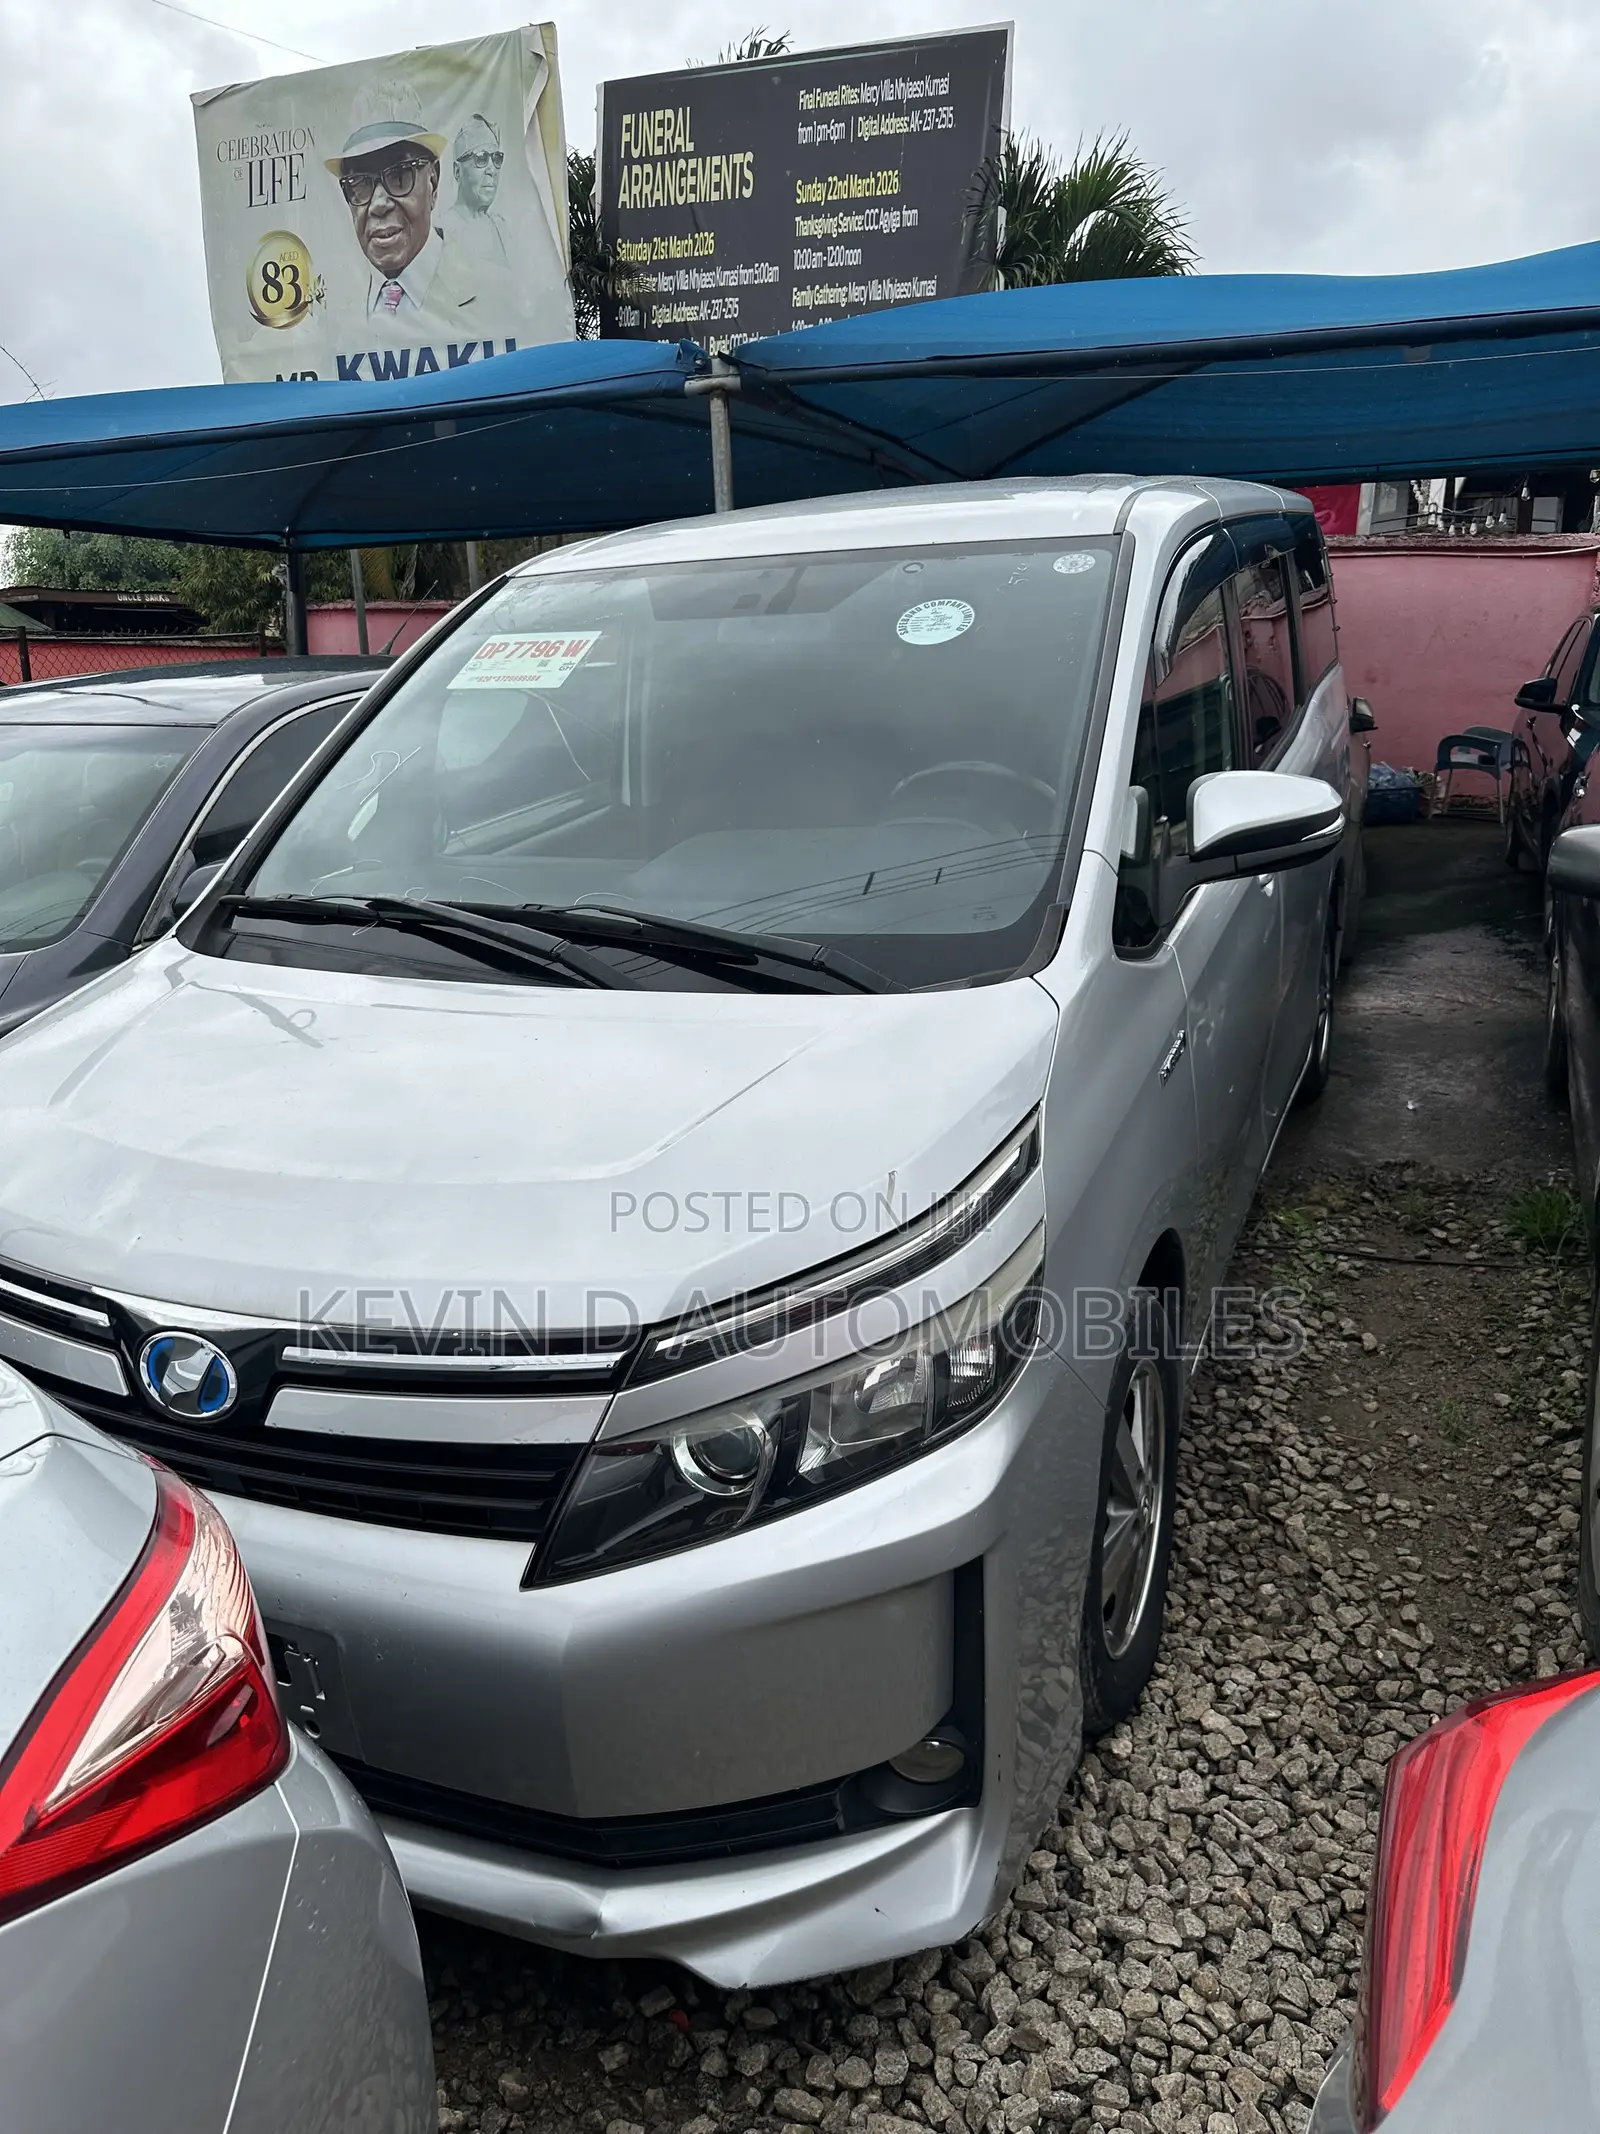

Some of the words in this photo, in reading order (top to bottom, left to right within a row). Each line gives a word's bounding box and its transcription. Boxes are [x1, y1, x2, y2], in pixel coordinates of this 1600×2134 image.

[799, 88, 816, 111] Final
[815, 84, 841, 109] Funeral
[841, 84, 860, 106] Rites:
[860, 82, 881, 107] Mercy
[880, 78, 895, 102] Villa
[924, 72, 950, 97] Kumasi
[217, 126, 315, 163] CELEBRATION
[620, 106, 695, 159] FUNERAL
[857, 113, 880, 142] Digital
[880, 112, 910, 135] Address:
[233, 167, 243, 180] OF
[246, 152, 307, 208] LIFE
[617, 151, 754, 209] ARRANGEMENTS
[796, 176, 827, 206] Sunday
[827, 173, 849, 201] 22nd
[849, 171, 876, 199] March
[876, 169, 899, 196] 2026
[795, 213, 838, 239] Thanksgiving
[838, 210, 864, 234] Service:
[864, 208, 879, 232] CCC
[902, 204, 919, 228] from
[616, 238, 652, 266] Saturday
[652, 237, 668, 260] 21st
[668, 233, 693, 258] March
[693, 231, 715, 257] 2026
[262, 261, 302, 310] 83
[657, 271, 676, 296] Mercy
[675, 268, 689, 290] Villa
[716, 265, 739, 287] Kumasi
[739, 264, 754, 285] from
[792, 284, 814, 310] Family
[814, 282, 848, 308] Gathering:
[848, 281, 868, 306] Mercy
[868, 279, 882, 301] Villa
[911, 275, 937, 299] Kumasi
[651, 304, 673, 328] Digital
[672, 301, 700, 323] Address:
[117, 593, 142, 602] UNCLE
[474, 642, 509, 660] DP
[505, 639, 566, 660] 7796
[561, 639, 591, 658] W
